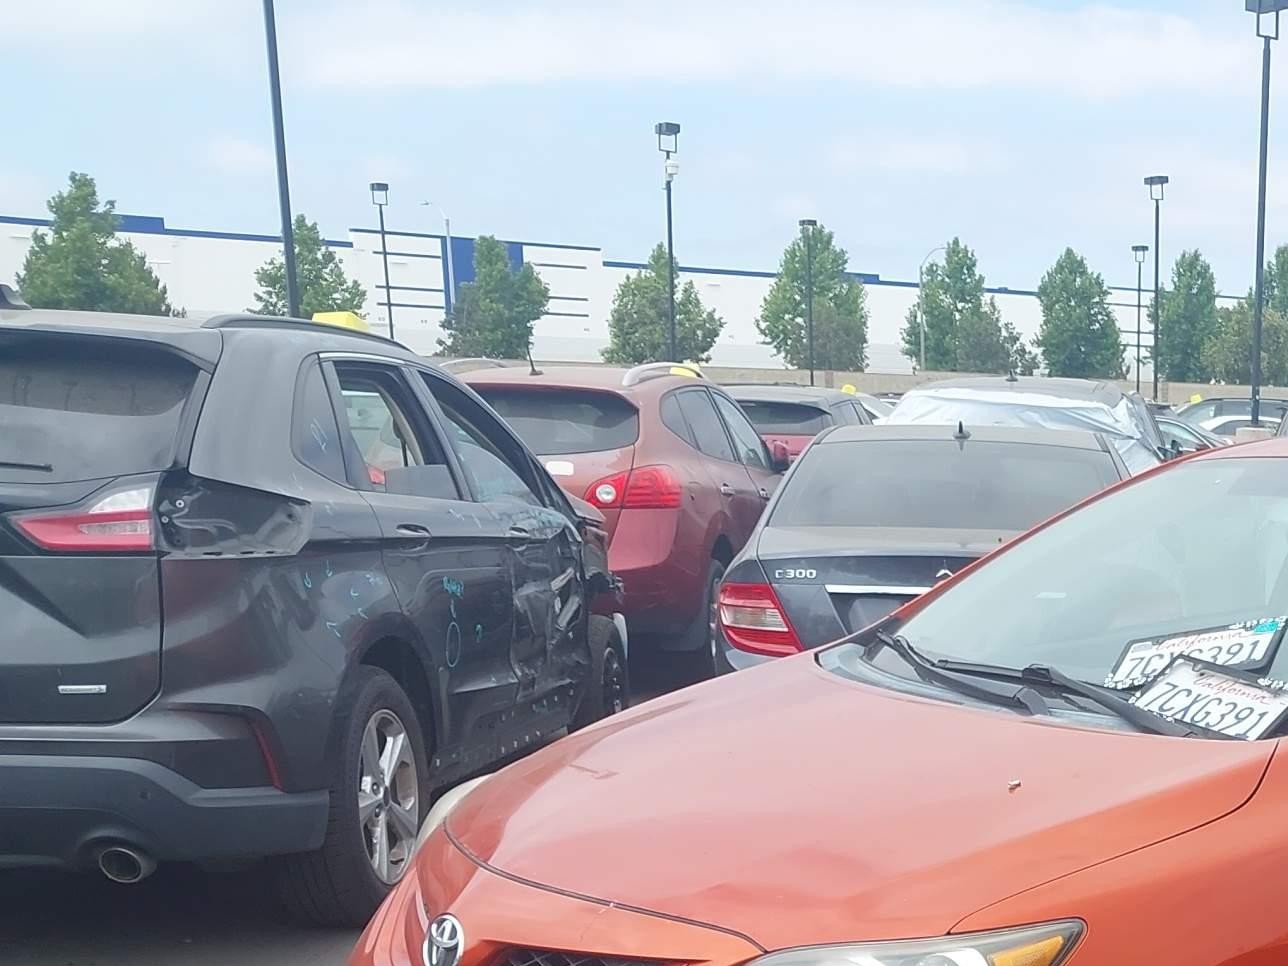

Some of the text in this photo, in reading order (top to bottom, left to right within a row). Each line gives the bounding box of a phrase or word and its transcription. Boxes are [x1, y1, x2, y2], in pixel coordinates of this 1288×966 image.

[775, 569, 817, 579] C300
[1193, 673, 1272, 704] California
[1144, 682, 1269, 738] 7CXG391
